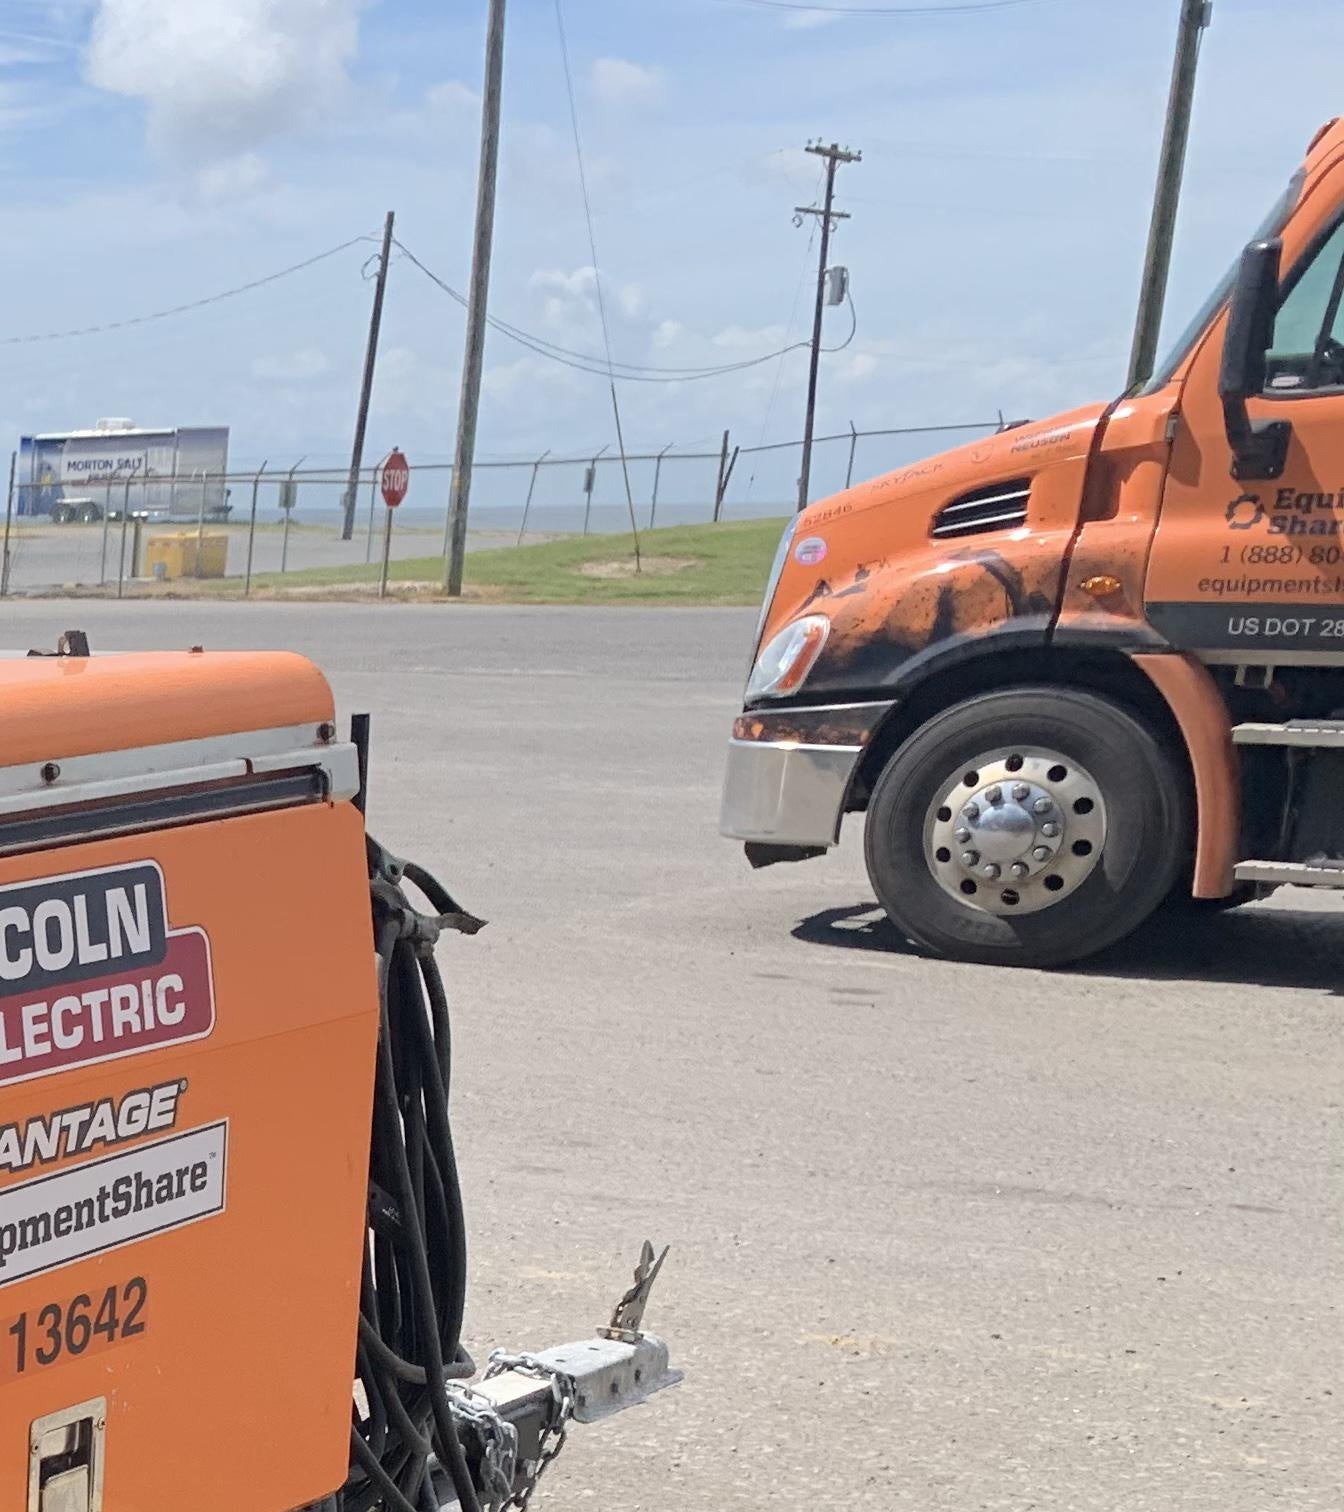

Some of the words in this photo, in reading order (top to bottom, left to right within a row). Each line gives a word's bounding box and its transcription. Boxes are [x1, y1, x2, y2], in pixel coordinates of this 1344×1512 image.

[67, 459, 113, 472] MORTON
[383, 468, 409, 491] STOP
[1267, 515, 1344, 535] Shar
[1220, 546, 1230, 563] 1
[1241, 545, 1303, 565] (888)
[1309, 545, 1344, 564] 80
[1228, 617, 1259, 635] US
[1264, 618, 1317, 636] DOT
